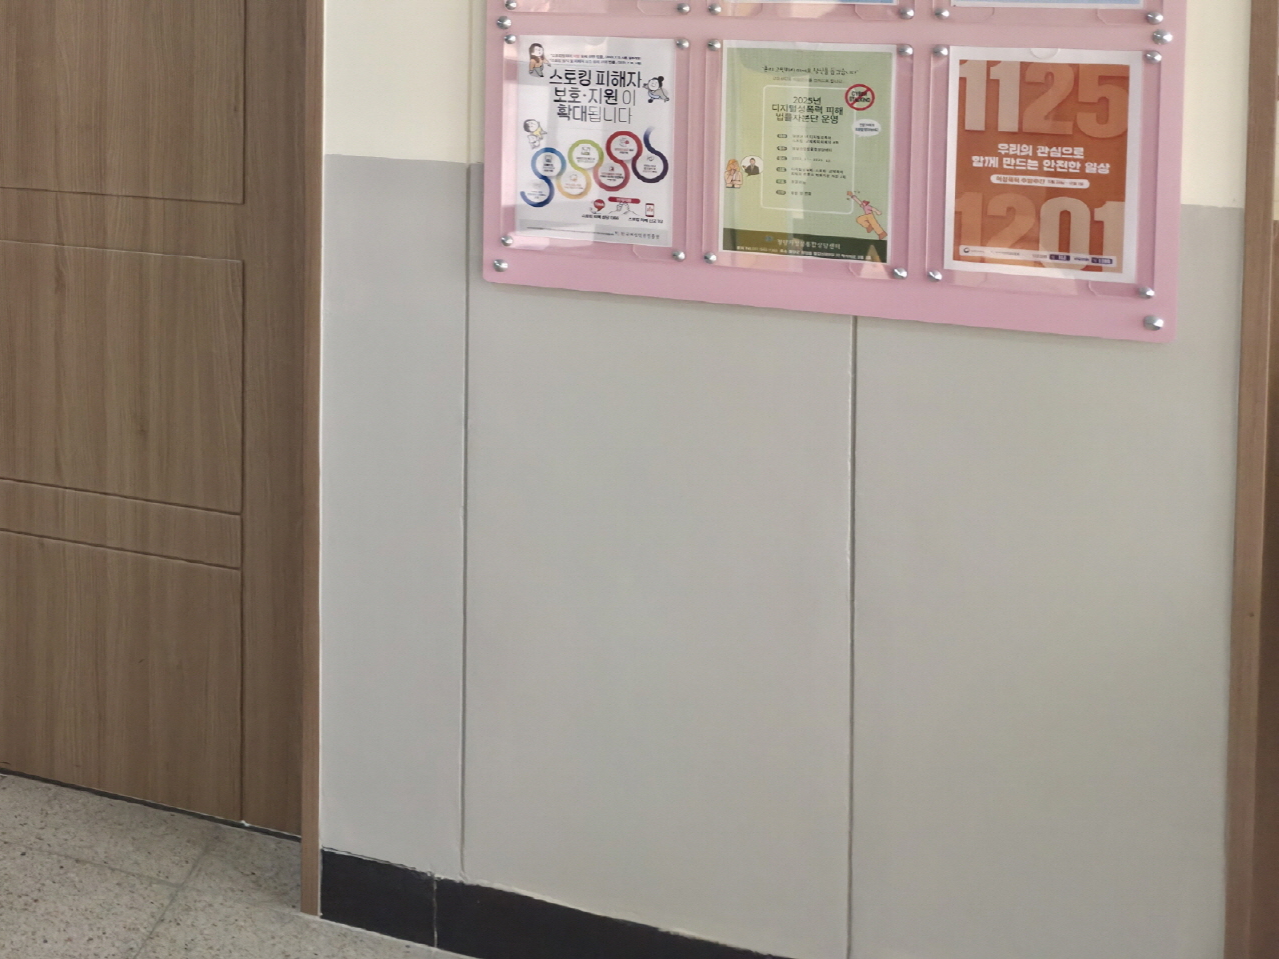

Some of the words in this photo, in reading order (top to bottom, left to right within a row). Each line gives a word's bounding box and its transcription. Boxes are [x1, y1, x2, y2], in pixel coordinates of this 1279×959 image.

[549, 69, 591, 86] 스토킹
[596, 70, 642, 88] 피해자
[793, 97, 821, 105] 2025년
[557, 104, 632, 124] 확대됩니다
[826, 107, 843, 115] 피해
[998, 143, 1032, 156] 우리의
[1037, 146, 1084, 159] 관심으로
[972, 156, 999, 168] 함께
[1003, 157, 1038, 170] 만드는
[1043, 160, 1080, 173] 안전한
[1085, 162, 1110, 174] 일상
